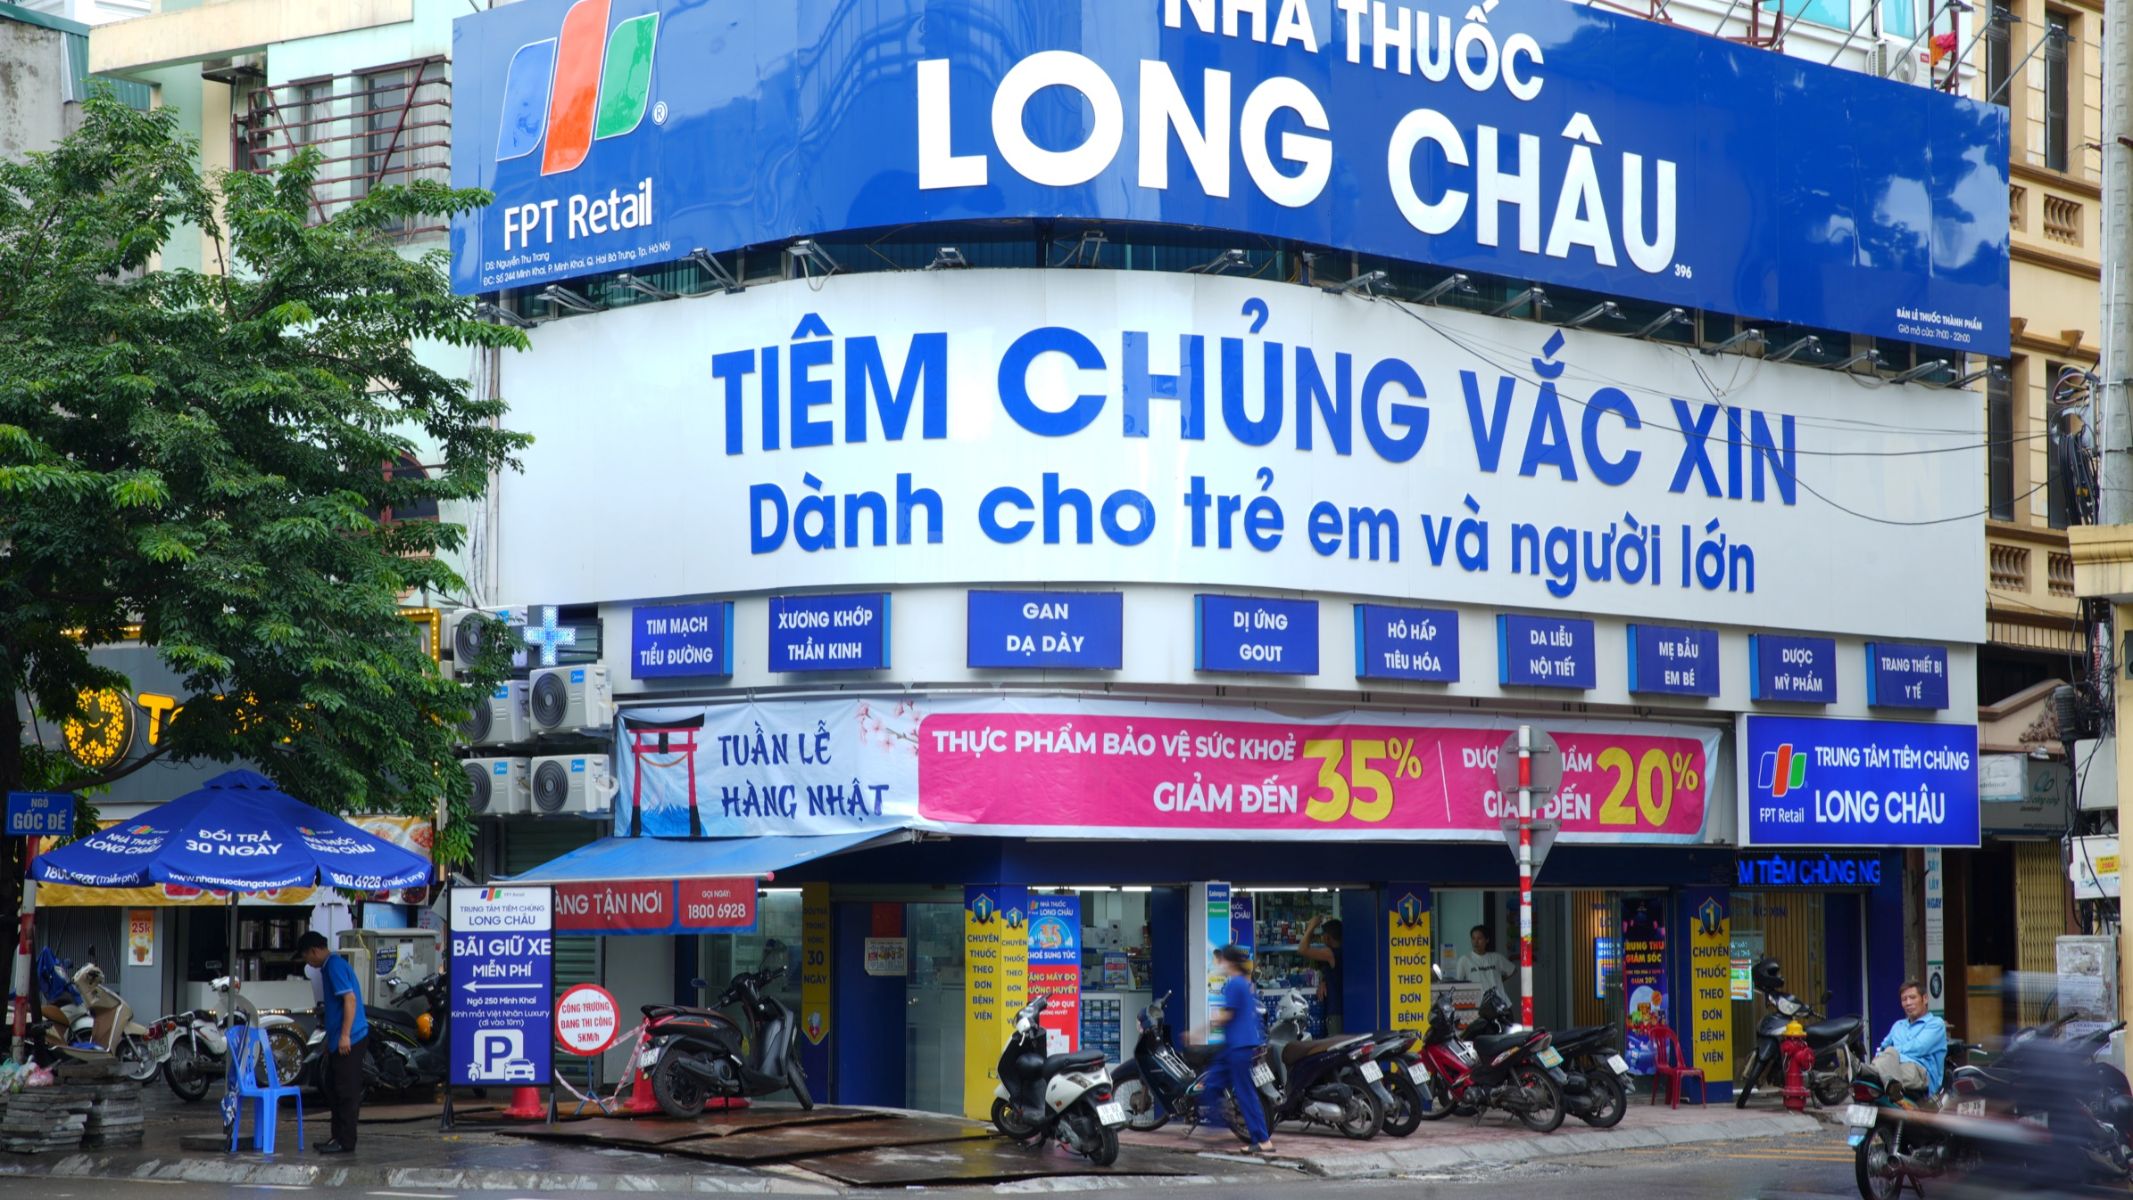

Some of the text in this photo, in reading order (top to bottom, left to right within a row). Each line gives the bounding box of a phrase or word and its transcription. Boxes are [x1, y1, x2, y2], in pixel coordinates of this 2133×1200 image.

[1337, 0, 1544, 101] THUỐC
[917, 50, 1677, 274] LONG CHÂU
[504, 177, 652, 251] FPT Retail
[516, 269, 531, 280] Minh
[554, 261, 570, 272] Minh
[596, 255, 607, 264] Hai
[659, 241, 671, 252] Nội
[533, 251, 550, 263] Trang
[1675, 264, 1692, 279] 396
[1953, 331, 1971, 343] 22h00
[712, 297, 1797, 506] TIÊM CHỦNG VẮC XIN
[749, 466, 1756, 599] Dành cho trẻ em và người lớn
[777, 606, 873, 630] XƯƠNG KHỚP
[1022, 602, 1069, 620] GAN
[646, 616, 708, 638] TIM MẠCH
[1233, 608, 1288, 633] DỊ ỨNG
[1387, 618, 1436, 642] HÔ HẤP
[1530, 625, 1573, 647] DA LIỄU
[640, 642, 714, 666] TIỂU ĐƯỜNG
[788, 637, 862, 660] THẦN KINH
[1006, 632, 1084, 658] DẠ DÀY
[1239, 644, 1283, 663] GOUT
[1659, 637, 1699, 659] MẸ BẦU
[1384, 648, 1441, 673] TIÊU HÓA
[1782, 648, 1813, 667] DƯỢC
[1530, 655, 1575, 679] NỘI TIẾT
[1881, 656, 1942, 678] TRANG THIẾT BỊ
[1664, 668, 1695, 687] EM BÉ
[1775, 670, 1823, 693] MỸ PHẨM
[1905, 682, 1922, 699] Y TẾ
[718, 719, 832, 766] TUẦN LỄ
[932, 723, 1296, 763] THỰC PHẨM BẢO VỆ SỨC KHOẺ
[1815, 743, 1969, 771] TRUNG TÂM TIÊM CHỦNG
[1302, 736, 1422, 823] 35%
[1596, 746, 1698, 827] 20%
[720, 778, 889, 821] HÀNG NHẬT
[1153, 772, 1298, 813] GIẢM ĐẾN
[1815, 783, 1945, 824] LONG CHÂU
[13, 806, 43, 830] GỐC
[1760, 807, 1804, 823] FPT Retail
[84, 838, 126, 853] LONG
[236, 830, 271, 843] TRẢ
[186, 839, 282, 856] 30 NGÀY
[1756, 854, 1796, 884] TIÊM
[1800, 852, 1856, 884] CHỦNG
[354, 874, 382, 888] 6928
[460, 905, 484, 913] TRUNG
[555, 888, 662, 921] ÀNG TẬN NƠI
[688, 903, 746, 919] 1800 6928
[1057, 907, 1074, 916] CHÂU
[469, 912, 536, 925] LONG CHÂU
[132, 922, 151, 934] 25k
[453, 934, 551, 956] BÃI GIỮ XE
[967, 933, 999, 943] CHUYÊN
[1391, 935, 1429, 947] CHUYÊN
[807, 950, 824, 966] 30
[970, 948, 997, 958] THUỐC
[1394, 951, 1426, 966] THUỐC
[1692, 943, 1729, 957] CHUYÊN
[472, 958, 533, 977] MIỄN PHÍ
[972, 965, 994, 974] THEO
[1046, 971, 1063, 980] MÁY
[1695, 963, 1727, 978] THUỐC
[974, 980, 992, 989] ĐƠN
[1397, 974, 1423, 984] THEO
[484, 997, 498, 1005] 250
[499, 996, 518, 1005] Minh
[519, 996, 537, 1005] Khai
[972, 995, 994, 1005] BỆNH
[1400, 992, 1422, 1003] ĐƠN
[1699, 988, 1724, 999] THEO
[524, 1010, 550, 1019] Luxury
[582, 1017, 593, 1028] THI
[974, 1011, 992, 1020] VIỆN
[1398, 1009, 1424, 1025] BỆNH
[1702, 1008, 1722, 1020] ĐƠN
[1700, 1028, 1725, 1044] BỆNH
[485, 1036, 512, 1072] P
[1702, 1050, 1724, 1065] VIỆN
